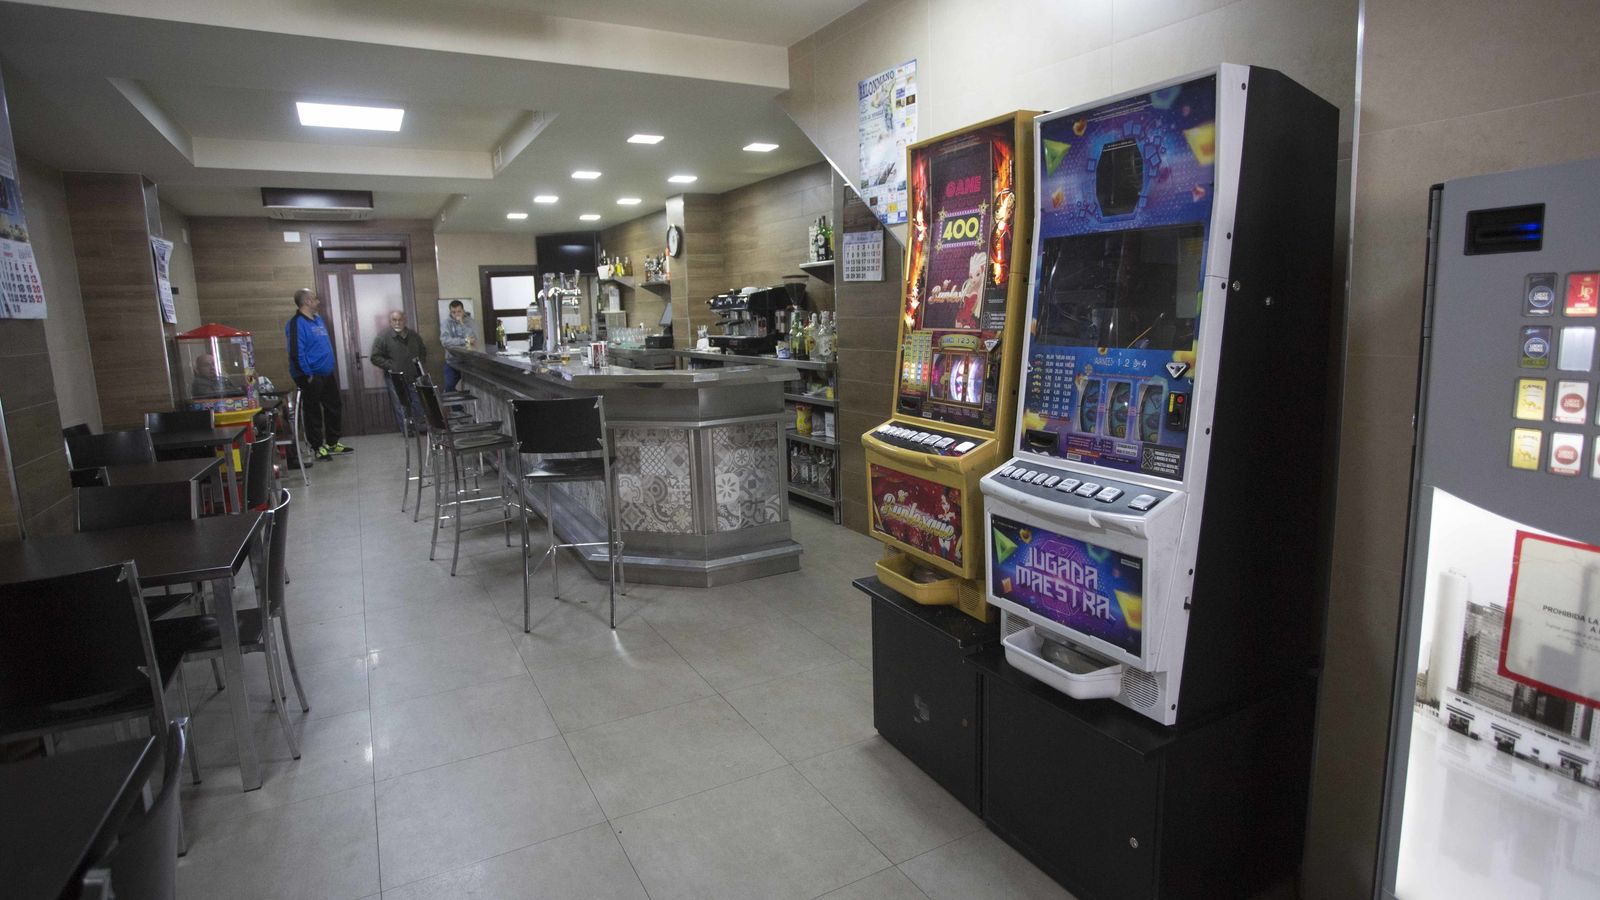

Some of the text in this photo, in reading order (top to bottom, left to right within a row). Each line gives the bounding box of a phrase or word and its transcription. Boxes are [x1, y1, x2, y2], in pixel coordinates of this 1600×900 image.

[945, 175, 982, 198] GAME
[942, 216, 980, 241] 400
[1025, 547, 1098, 590] JUGADA
[1015, 564, 1110, 620] MAESTRA
[1542, 604, 1598, 626] PROHIBIDA LA
